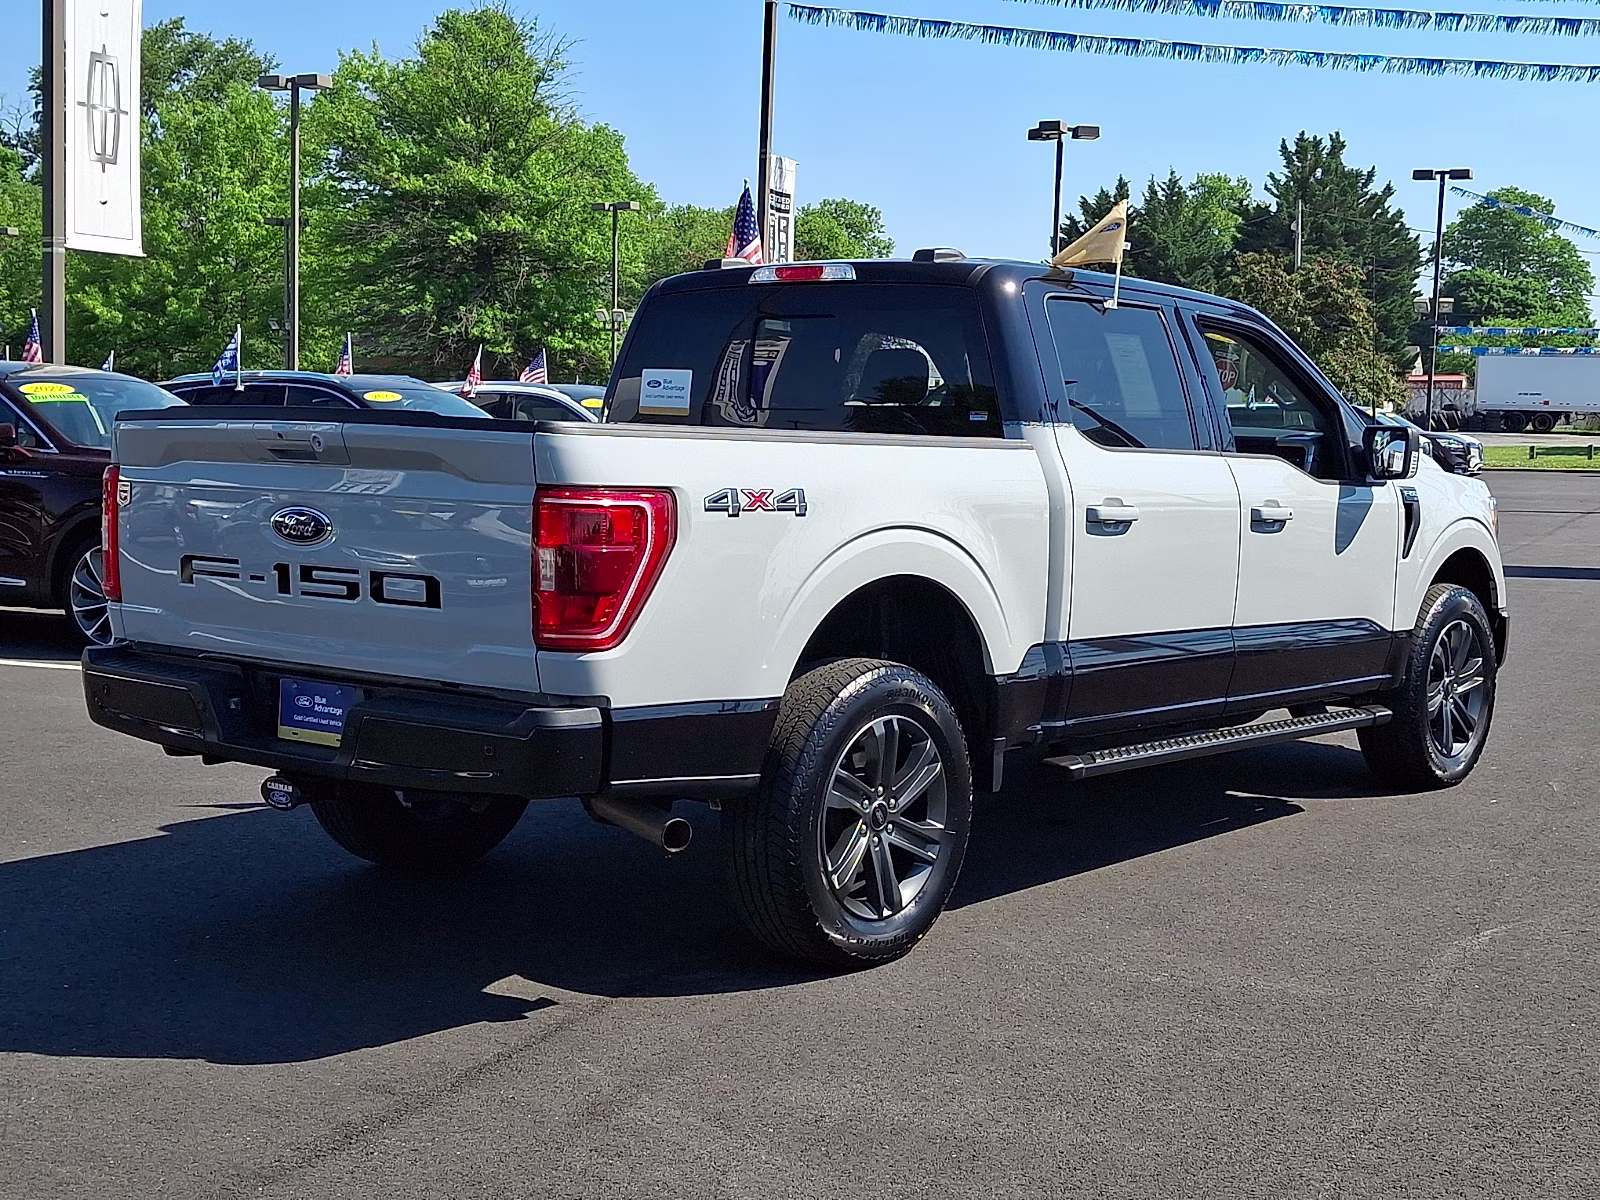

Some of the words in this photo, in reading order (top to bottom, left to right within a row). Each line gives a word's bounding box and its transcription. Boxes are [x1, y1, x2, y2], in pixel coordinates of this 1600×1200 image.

[1217, 369, 1236, 383] TOP
[281, 514, 316, 537] Ford
[178, 553, 443, 612] F-150
[314, 695, 327, 704] Blue
[314, 704, 343, 716] Advantage
[303, 715, 319, 723] Certified
[266, 781, 293, 792] CARMAN
